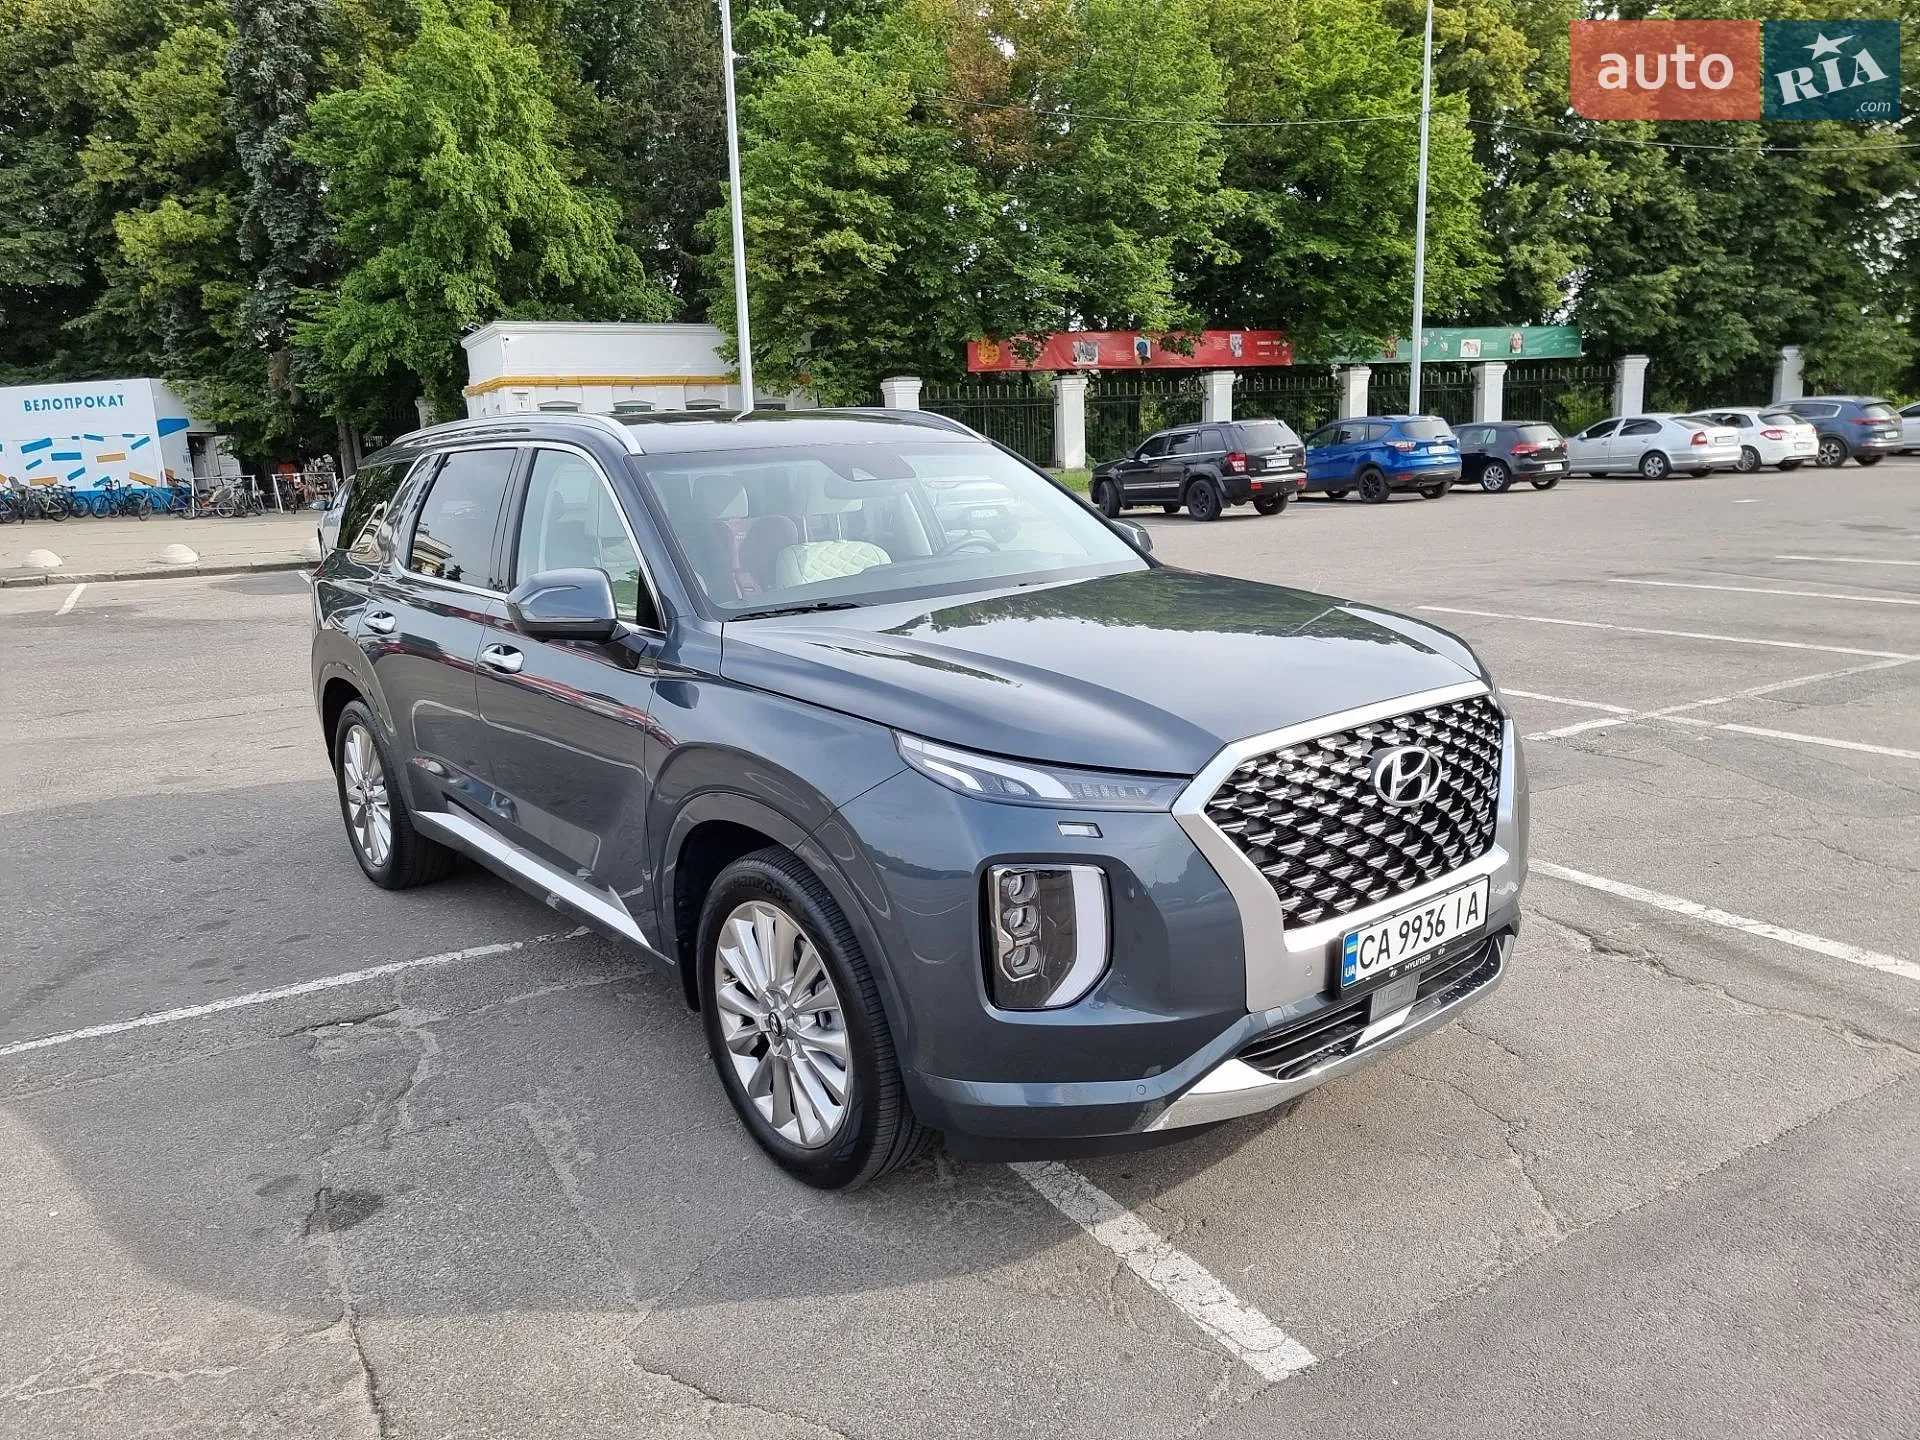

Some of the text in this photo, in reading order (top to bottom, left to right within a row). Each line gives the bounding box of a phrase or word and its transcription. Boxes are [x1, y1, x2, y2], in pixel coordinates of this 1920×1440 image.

[24, 394, 124, 411] ВЕЛОПРОКАТ
[1359, 892, 1479, 970] CA 9936 IA
[1345, 965, 1356, 977] UA
